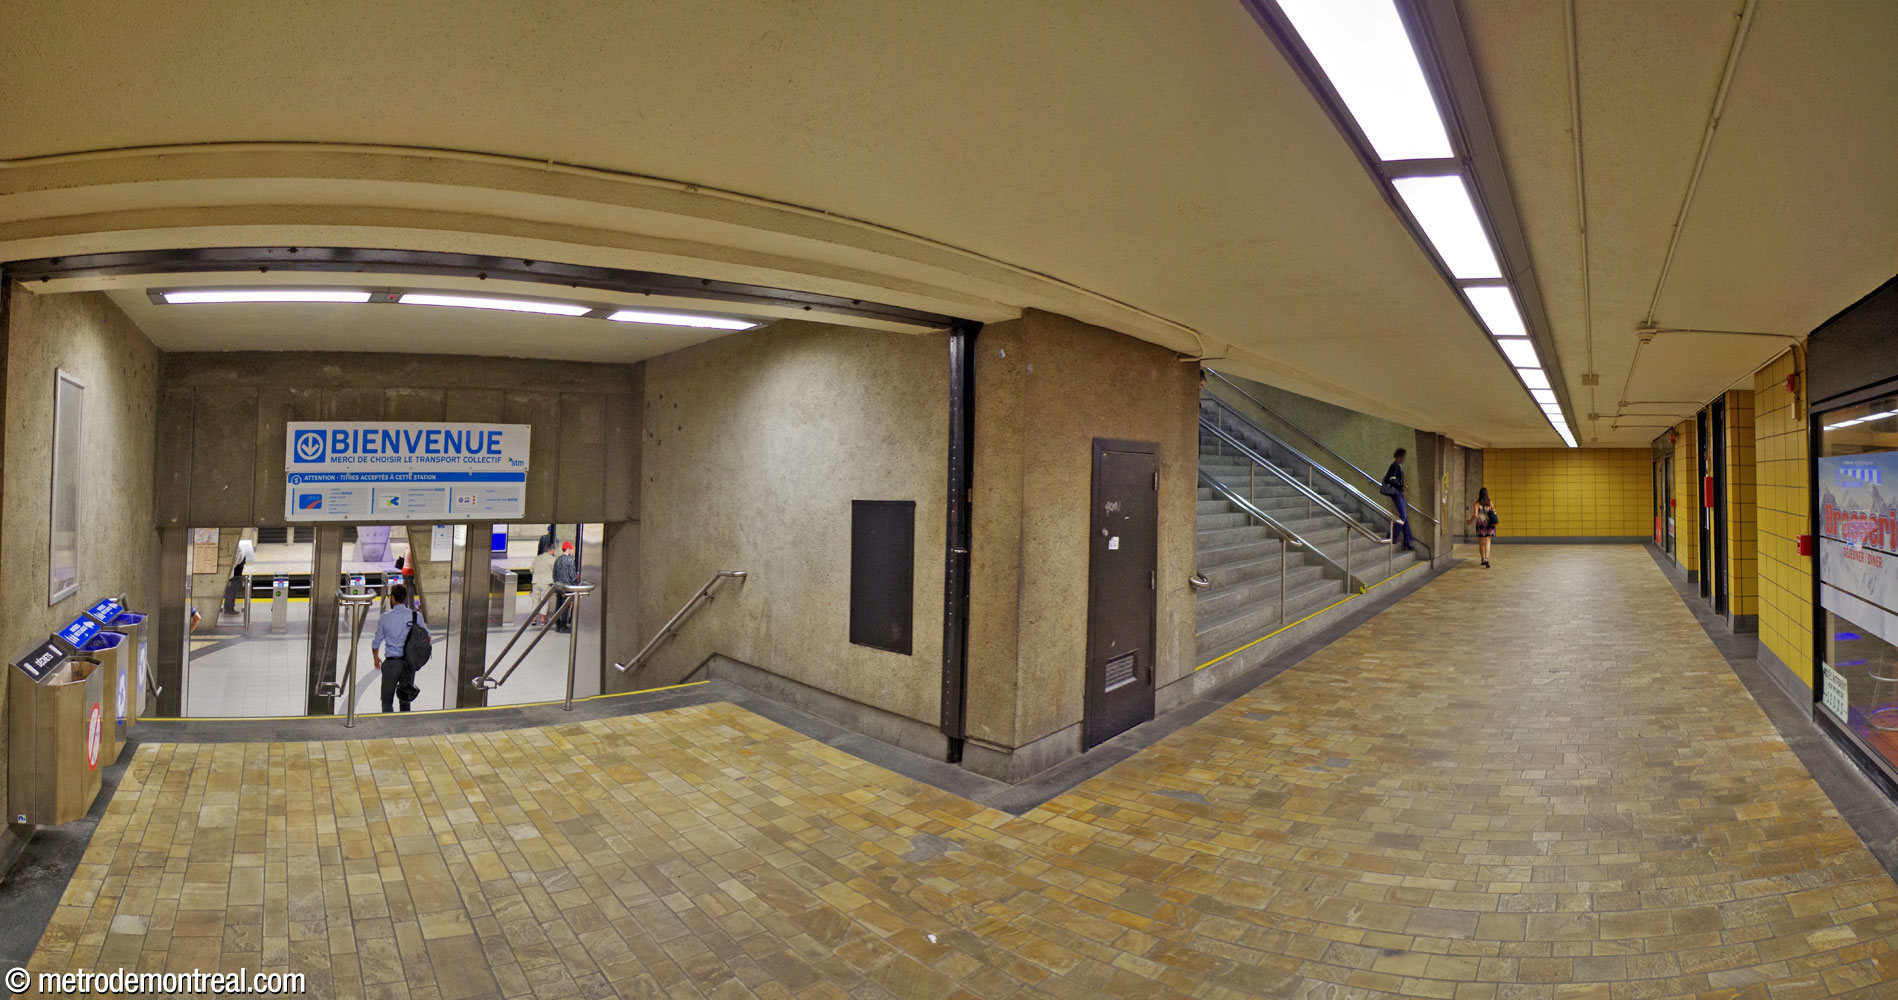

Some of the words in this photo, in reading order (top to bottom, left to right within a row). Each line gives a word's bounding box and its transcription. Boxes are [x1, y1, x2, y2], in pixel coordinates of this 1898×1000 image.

[331, 429, 503, 455] BIENVENUE
[511, 459, 525, 467] stm
[360, 473, 389, 481] ACCEPTÉS
[1824, 503, 1898, 552] Brasseri
